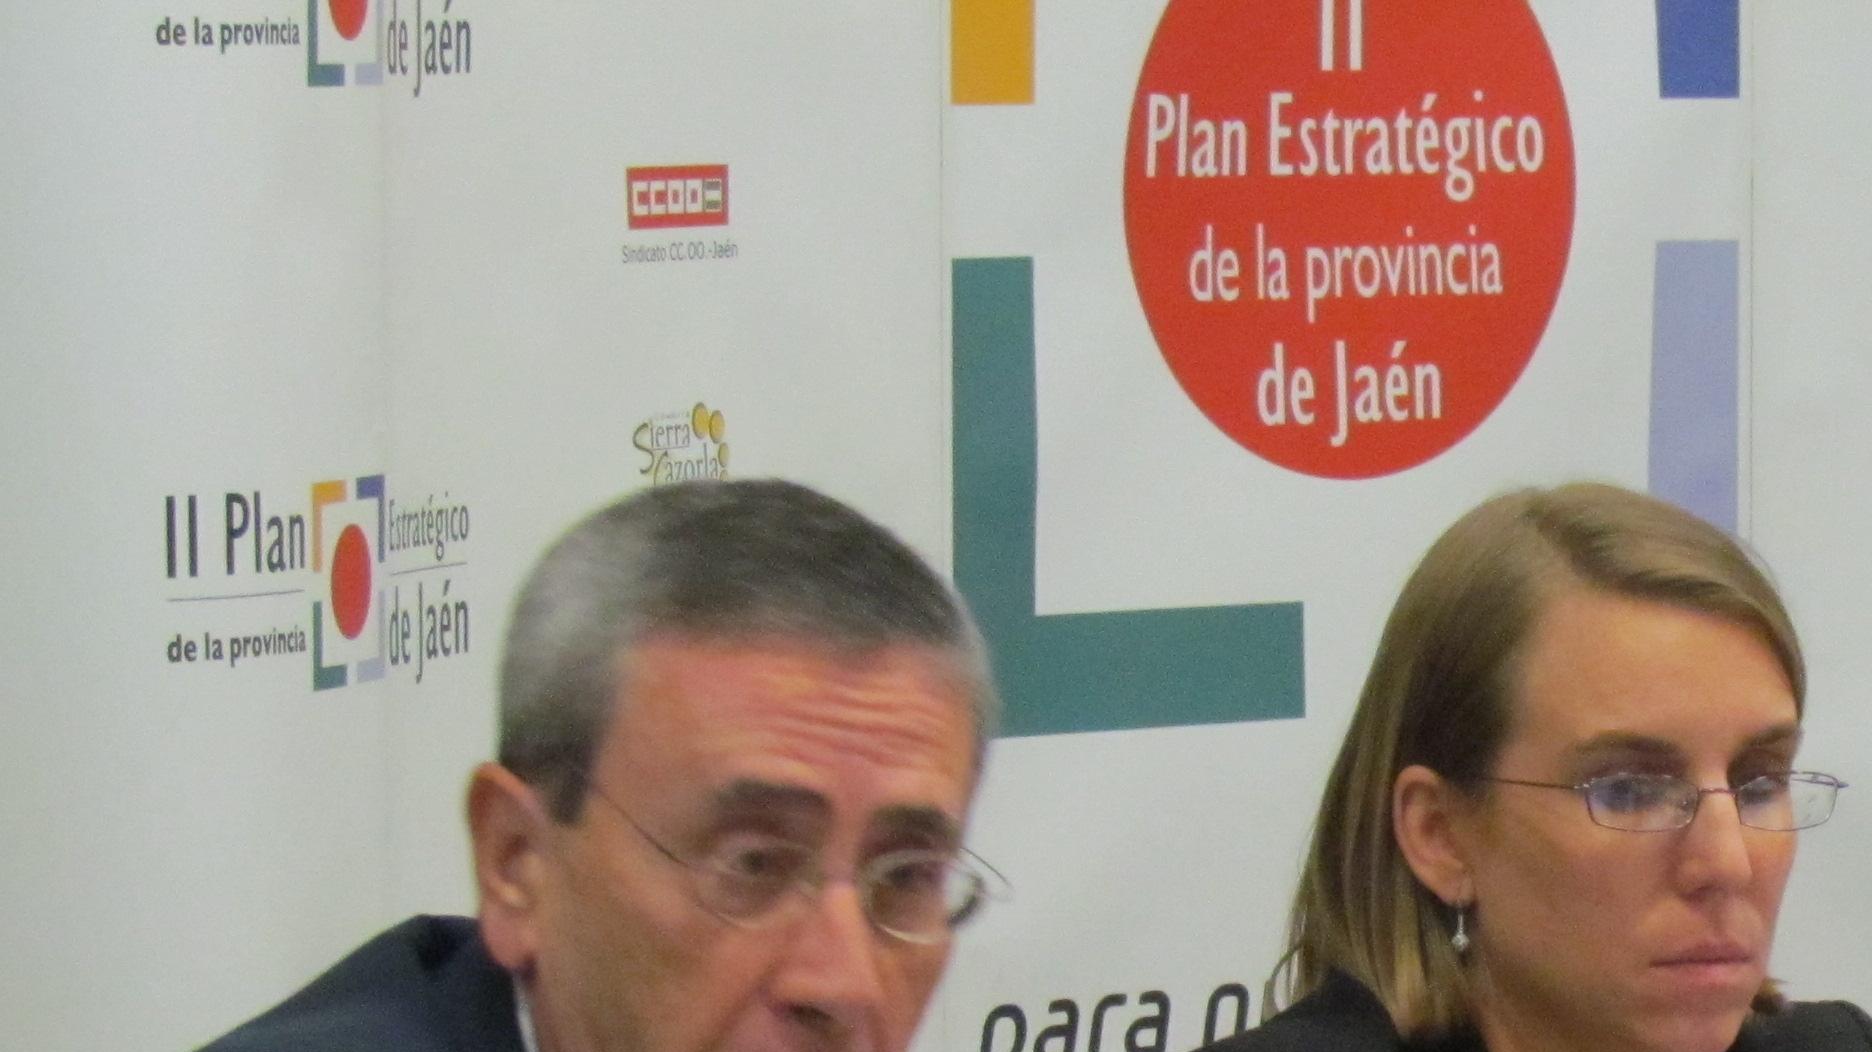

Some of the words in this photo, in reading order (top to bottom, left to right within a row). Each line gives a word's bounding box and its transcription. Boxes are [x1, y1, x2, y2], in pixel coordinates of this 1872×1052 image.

[155, 16, 187, 46] de
[193, 16, 214, 45] la
[220, 16, 300, 54] provincia
[387, 0, 409, 76] de
[413, 0, 471, 98] Jaén
[1145, 93, 1247, 178] Plan
[1269, 89, 1545, 203] Estratégico
[1189, 223, 1240, 302] de
[1256, 223, 1290, 300] la
[1306, 223, 1503, 324] provincia
[1257, 342, 1315, 426] de
[1330, 339, 1441, 447] Jaén
[164, 495, 199, 579] II
[225, 490, 306, 576] Plan
[389, 491, 470, 562] Estratégico
[167, 633, 198, 663] de
[205, 631, 225, 658] la
[230, 625, 307, 668] provincia
[389, 586, 412, 666] de
[416, 579, 470, 684] Jaén
